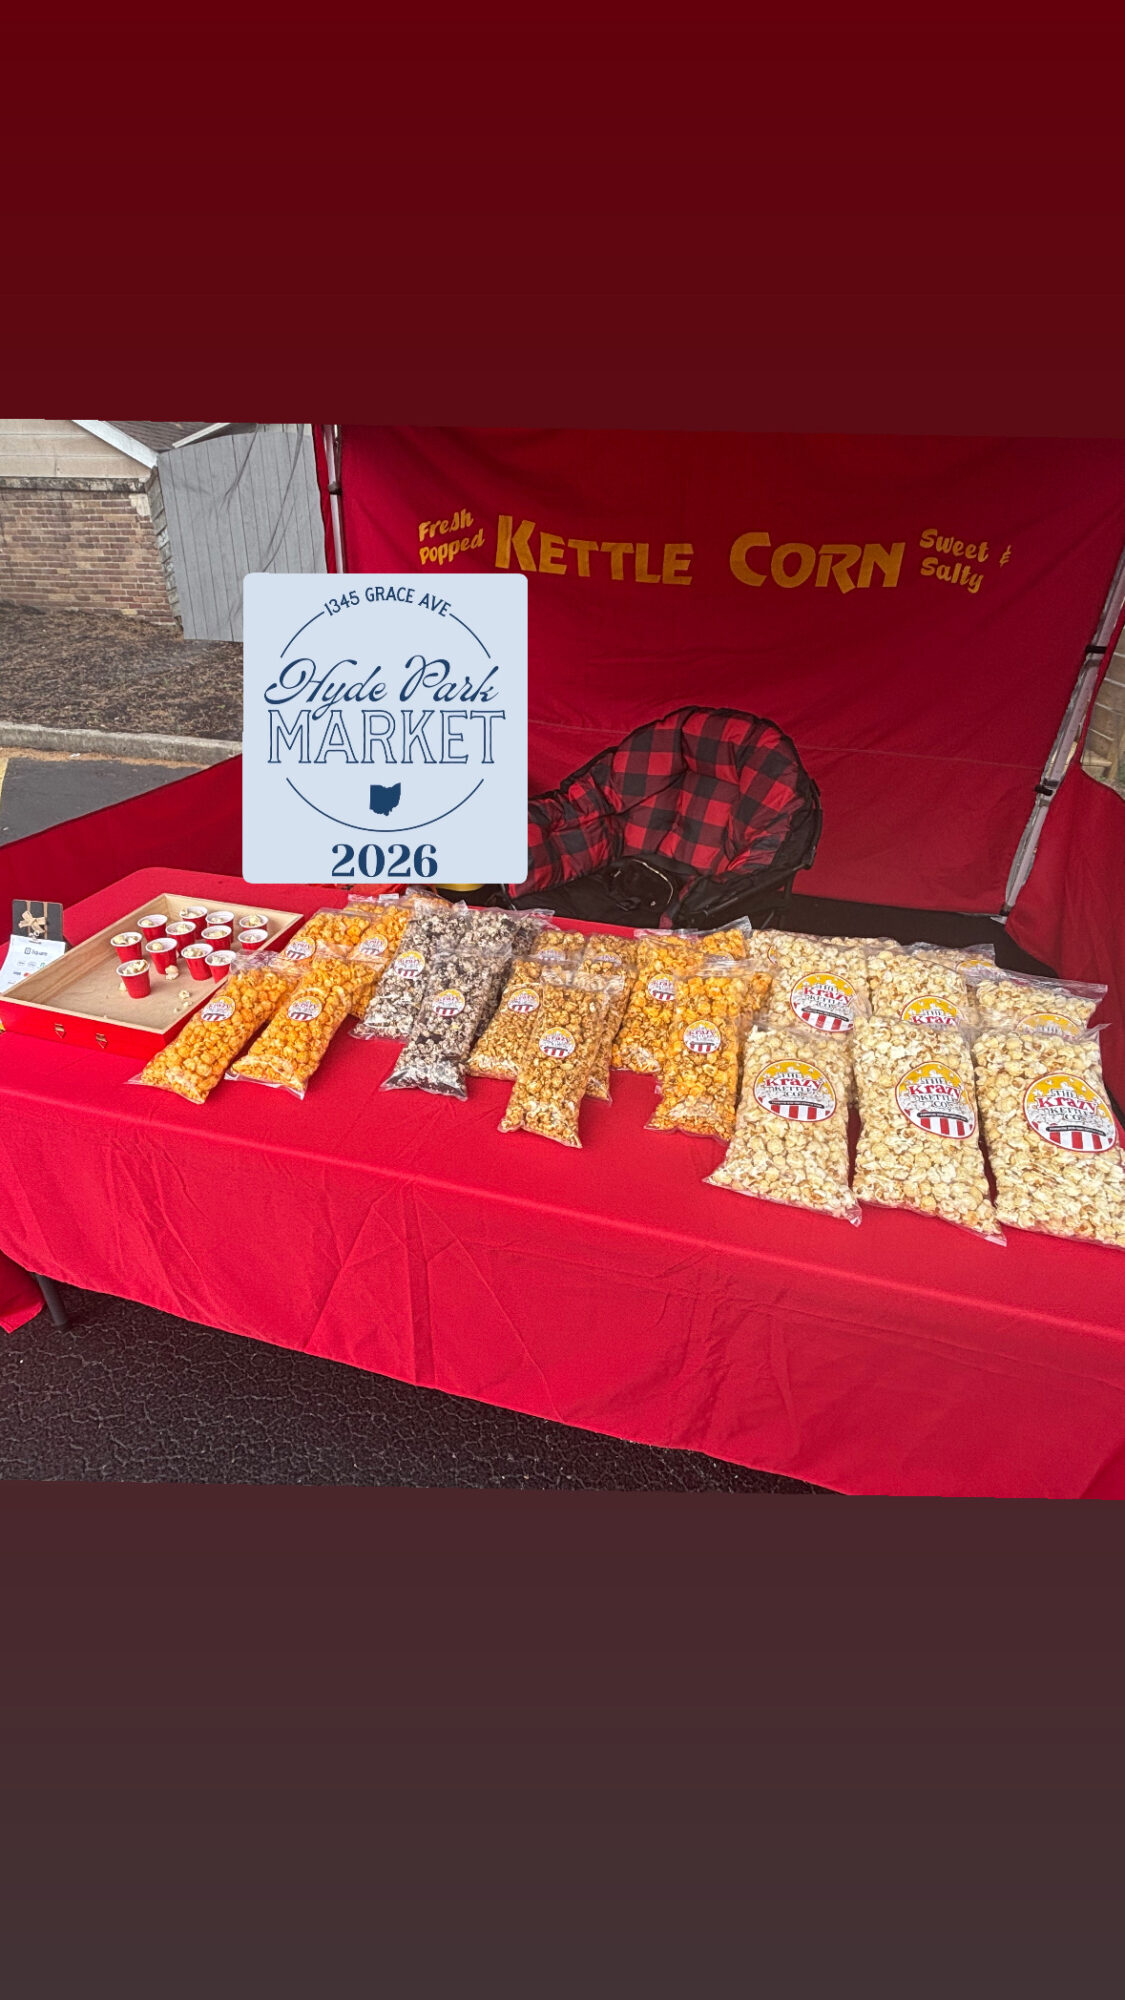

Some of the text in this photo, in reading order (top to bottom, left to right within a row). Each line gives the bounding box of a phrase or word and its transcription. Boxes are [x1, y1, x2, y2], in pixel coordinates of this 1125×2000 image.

[419, 508, 474, 542] Fresh
[495, 514, 906, 593] KETTLE CORN
[920, 528, 989, 563] Sweet
[920, 556, 984, 594] Salty
[804, 987, 851, 1005] Krazy
[765, 1078, 822, 1092] Krazy
[909, 1084, 961, 1101] Krazy
[1037, 1096, 1097, 1114] Krazy
